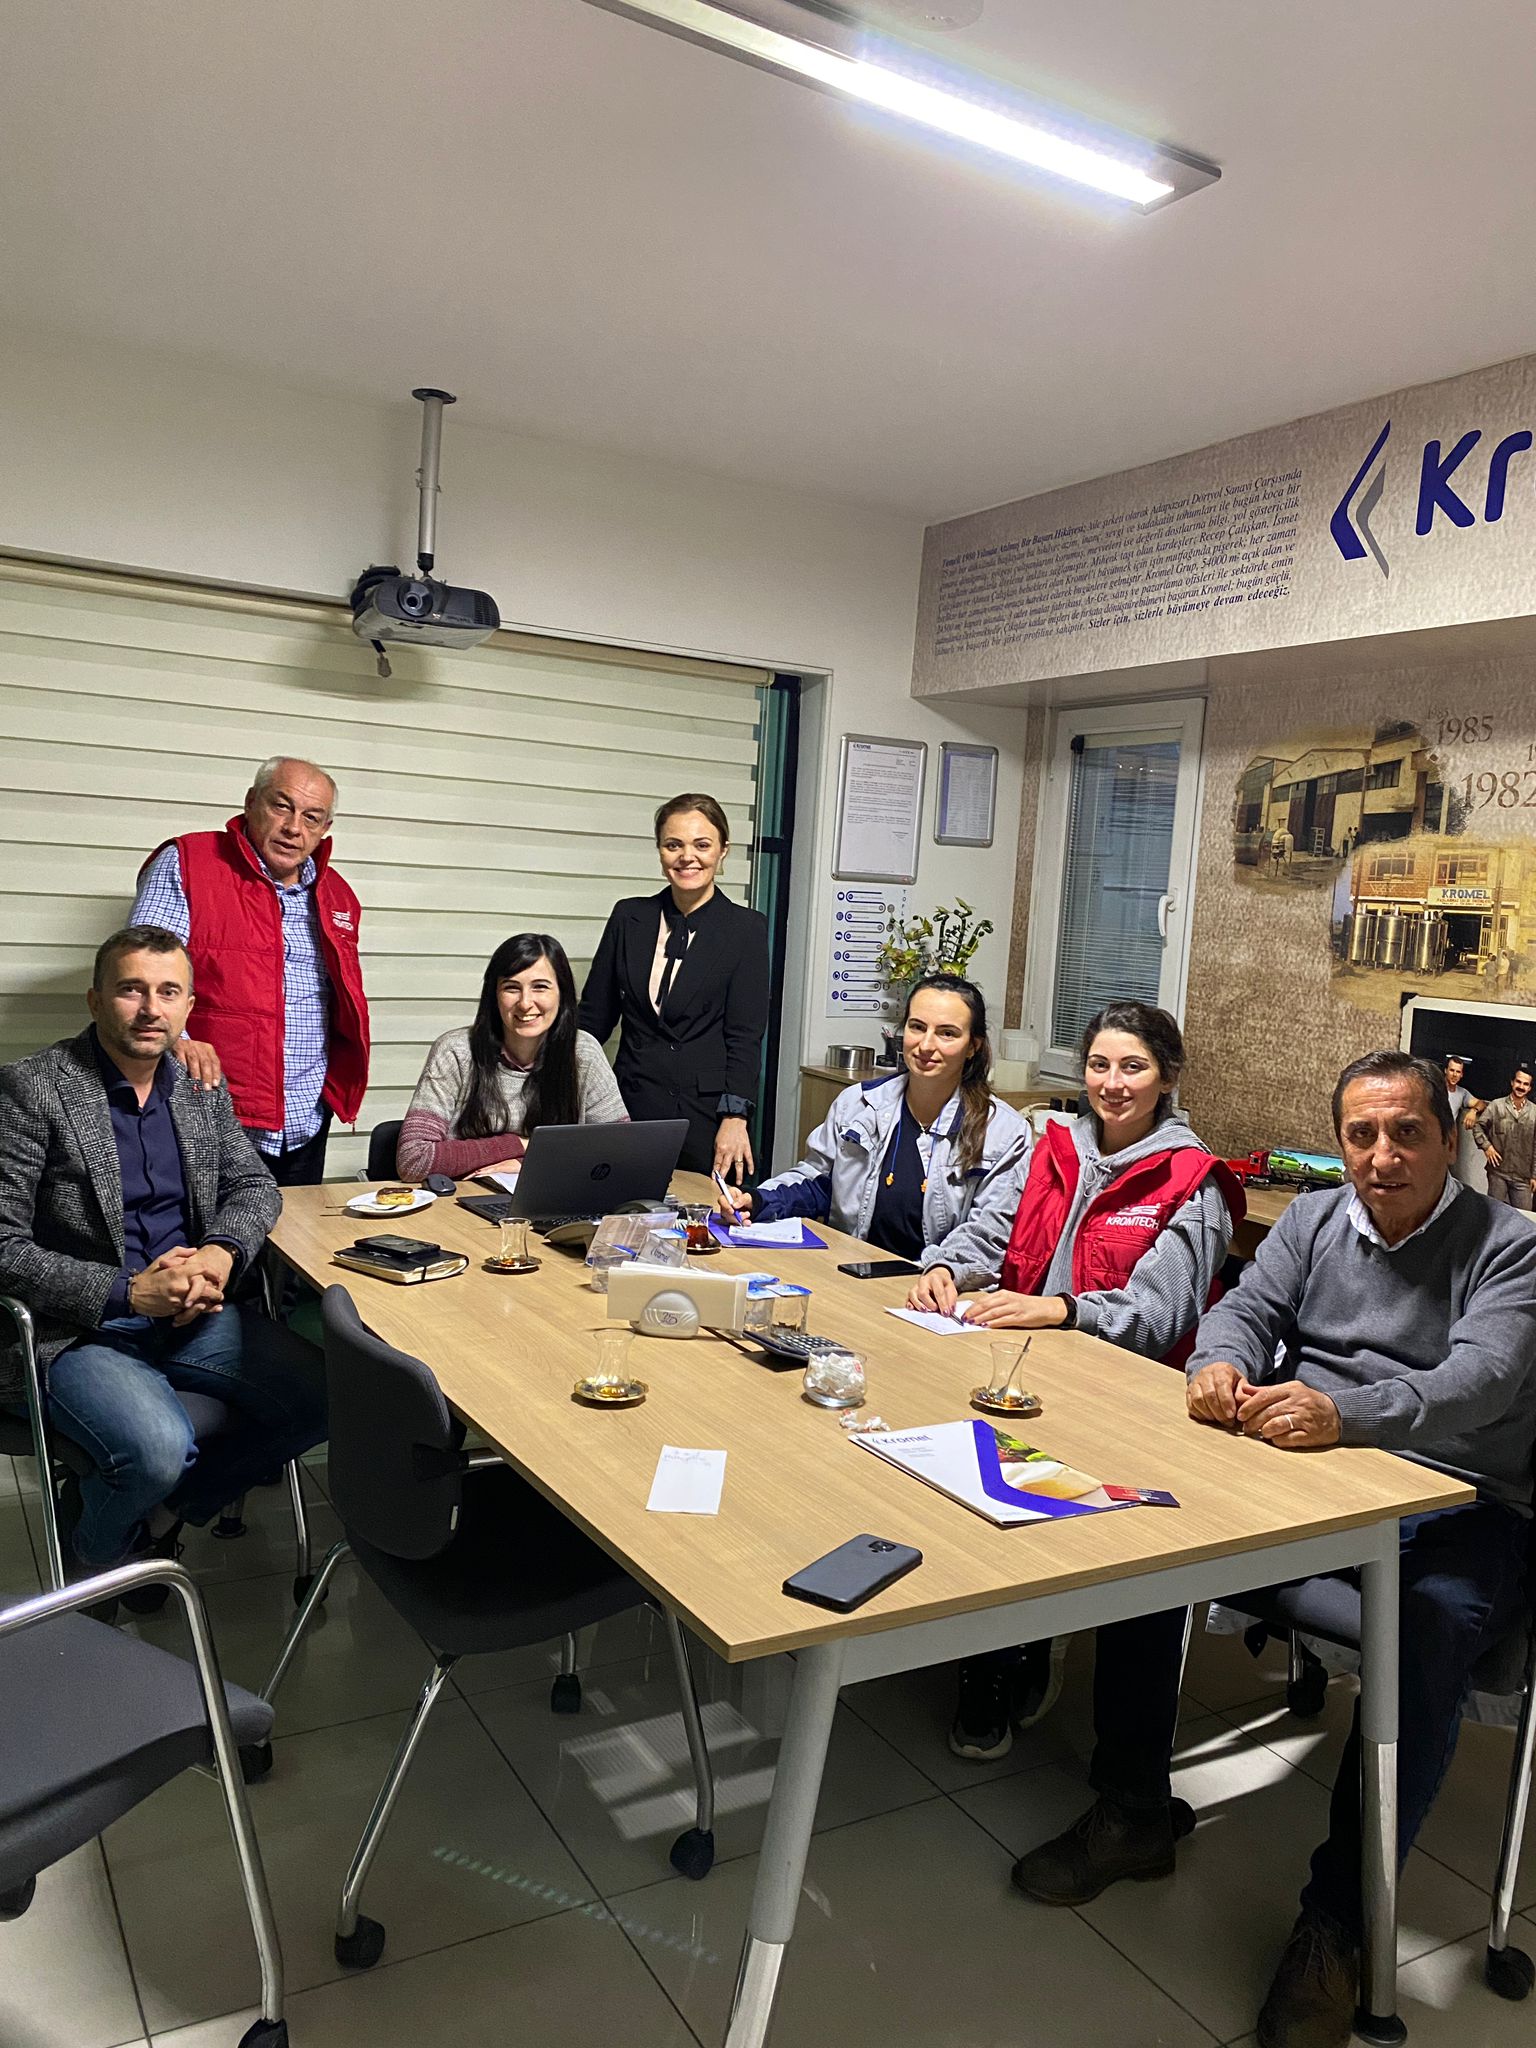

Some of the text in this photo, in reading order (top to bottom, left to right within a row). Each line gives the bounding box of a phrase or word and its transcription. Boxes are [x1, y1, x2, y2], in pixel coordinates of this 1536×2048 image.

[1150, 498, 1189, 515] Adapazarı
[1192, 487, 1224, 505] Dörtyol
[1224, 480, 1253, 497] Sanayi
[1254, 468, 1302, 492] Çarşısında
[1177, 505, 1217, 522] tohumları
[1219, 500, 1230, 511] ile
[1233, 493, 1260, 508] bugün
[1263, 488, 1284, 501] koca
[1286, 483, 1302, 495] bir
[1156, 536, 1197, 552] kardeşler;
[1200, 530, 1226, 543] Recep
[1228, 520, 1269, 539] Çalışkan,
[1273, 511, 1299, 526] İsmet
[1164, 521, 1206, 538] dostlarına
[1209, 514, 1230, 528] bilgi,
[1233, 509, 1247, 524] yol
[1250, 496, 1300, 521] göstericilik
[1146, 565, 1174, 580] Kromel
[1176, 563, 1198, 574] Grup,
[1201, 554, 1228, 569] 54000
[1242, 547, 1261, 563] açık
[1262, 545, 1283, 557] alan
[1285, 542, 1297, 552] ve
[1150, 556, 1164, 569] işin
[1165, 545, 1212, 563] mutfağında
[1212, 537, 1248, 556] pişerek;
[1250, 534, 1265, 545] her
[1267, 528, 1297, 542] zaman
[1141, 579, 1183, 597] pazarlama
[1185, 571, 1216, 587] ofisleri
[1217, 569, 1228, 579] ile
[1230, 561, 1269, 577] sektörde
[1271, 556, 1294, 569] emin
[1167, 589, 1200, 603] başaran
[1201, 581, 1234, 596] Kromel;
[1237, 576, 1264, 590] bugün
[1265, 570, 1292, 587] güçlü,
[1166, 600, 1211, 616] büyümeye
[1213, 594, 1244, 607] devam
[1246, 586, 1290, 601] edeceğiz.
[1436, 715, 1494, 745] 1985
[1461, 769, 1536, 810] 1982
[1441, 888, 1491, 899] KROMEL
[1105, 1215, 1160, 1229] KROMTECH
